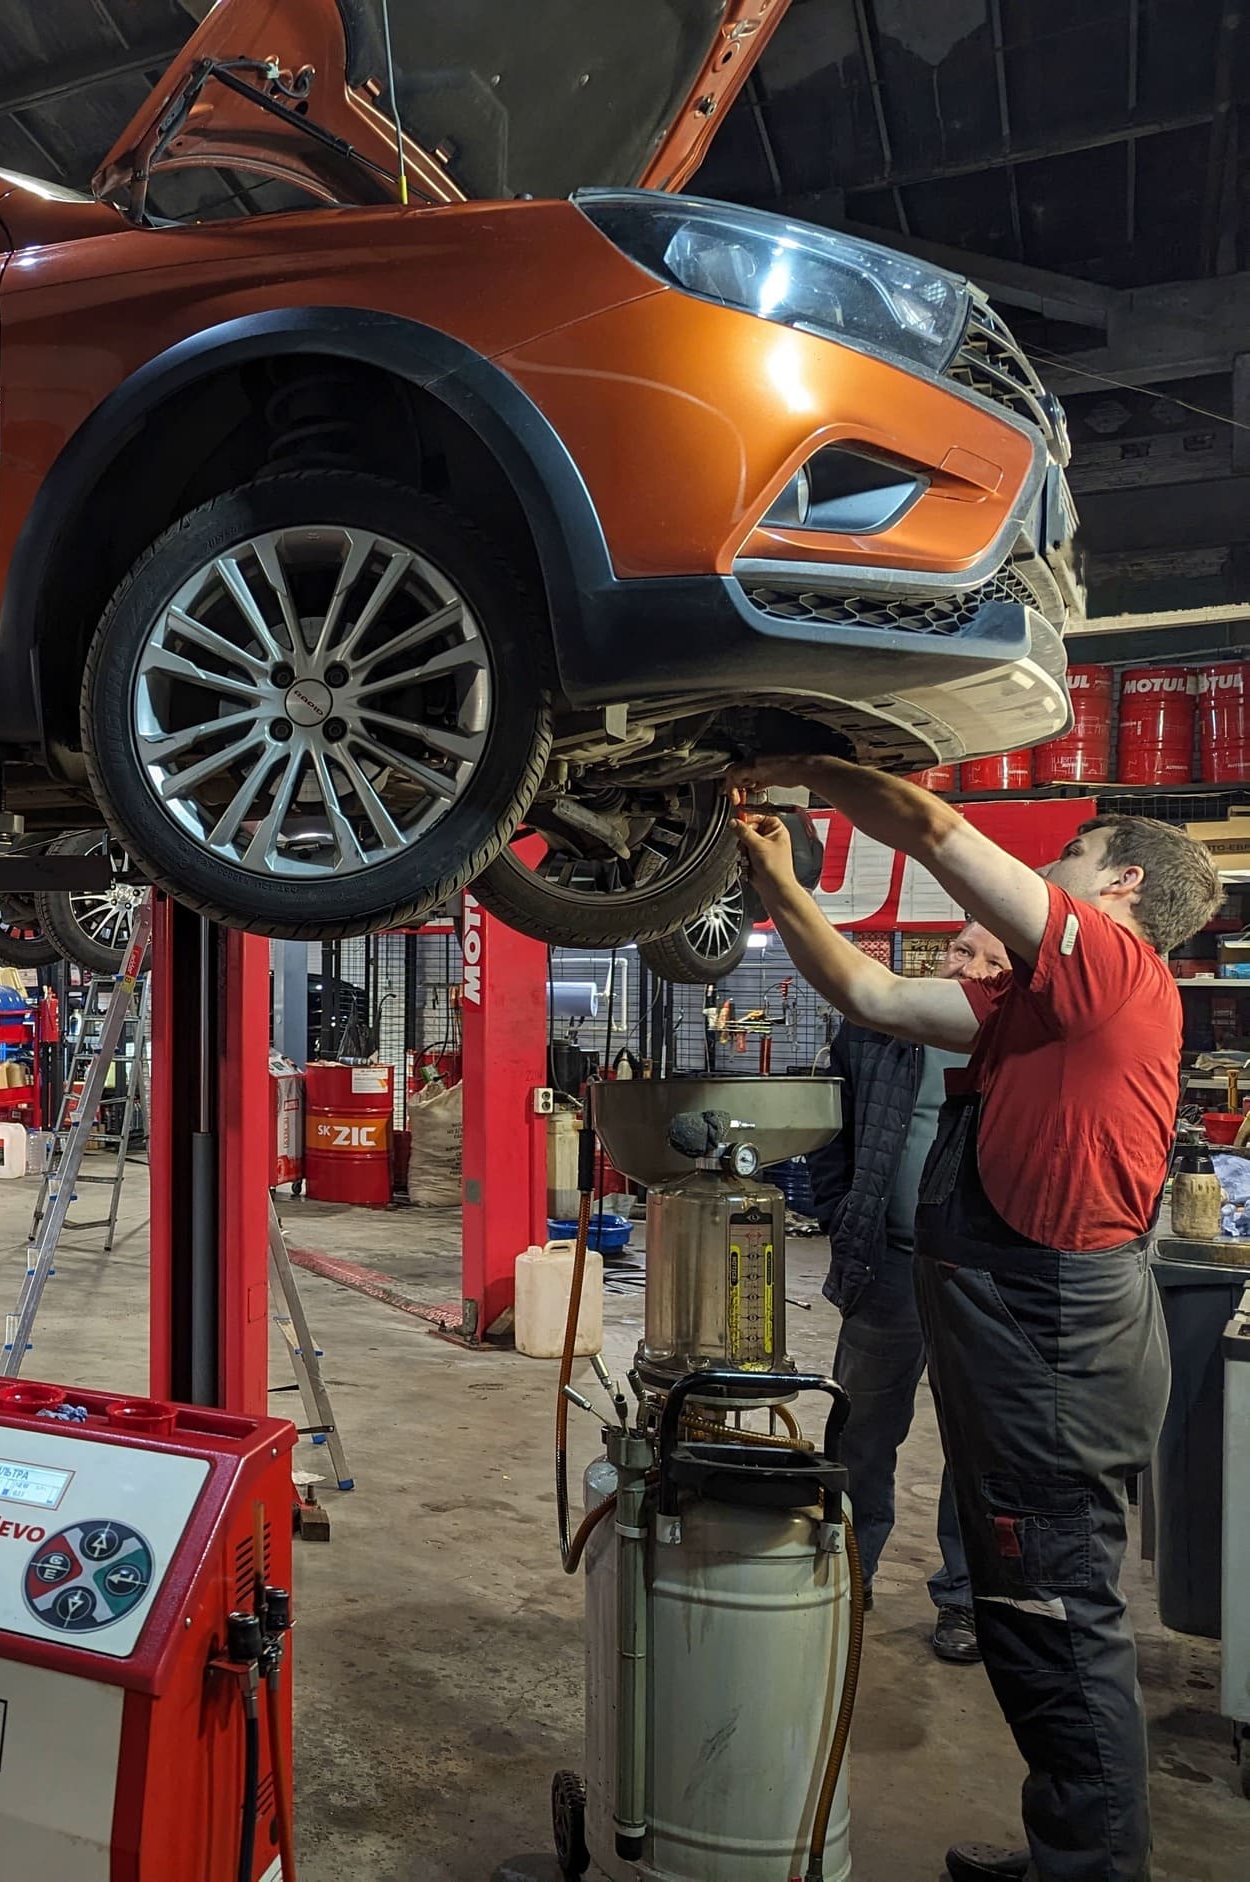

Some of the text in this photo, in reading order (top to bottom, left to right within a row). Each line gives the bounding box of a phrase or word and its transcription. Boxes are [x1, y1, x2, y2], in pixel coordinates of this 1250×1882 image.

[1123, 677, 1186, 695] MOTUL
[317, 1125, 377, 1146] SK ZIC
[43, 1568, 57, 1580] E
